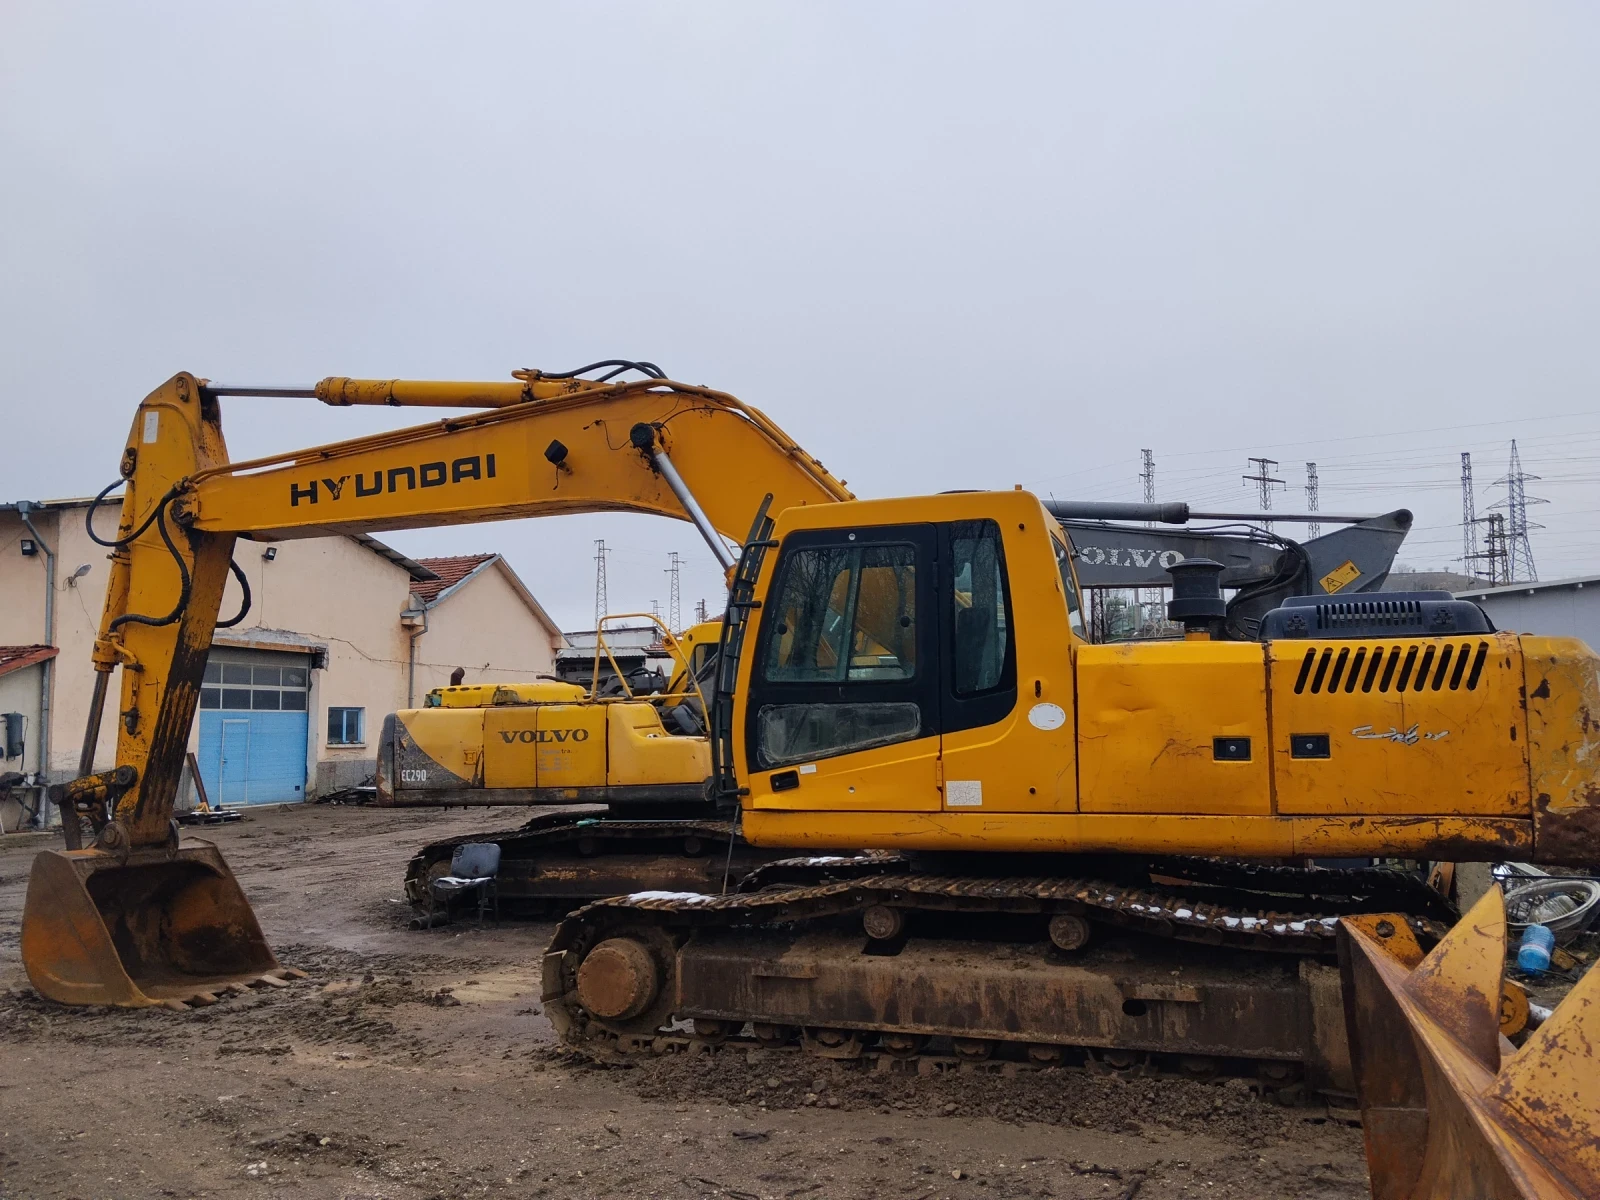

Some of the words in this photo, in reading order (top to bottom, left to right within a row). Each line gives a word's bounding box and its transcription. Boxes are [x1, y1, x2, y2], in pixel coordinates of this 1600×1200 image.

[291, 454, 496, 507] HYUNDAI
[1075, 545, 1185, 568] OLVO
[498, 729, 589, 744] VOLVO
[401, 769, 427, 782] EC290
